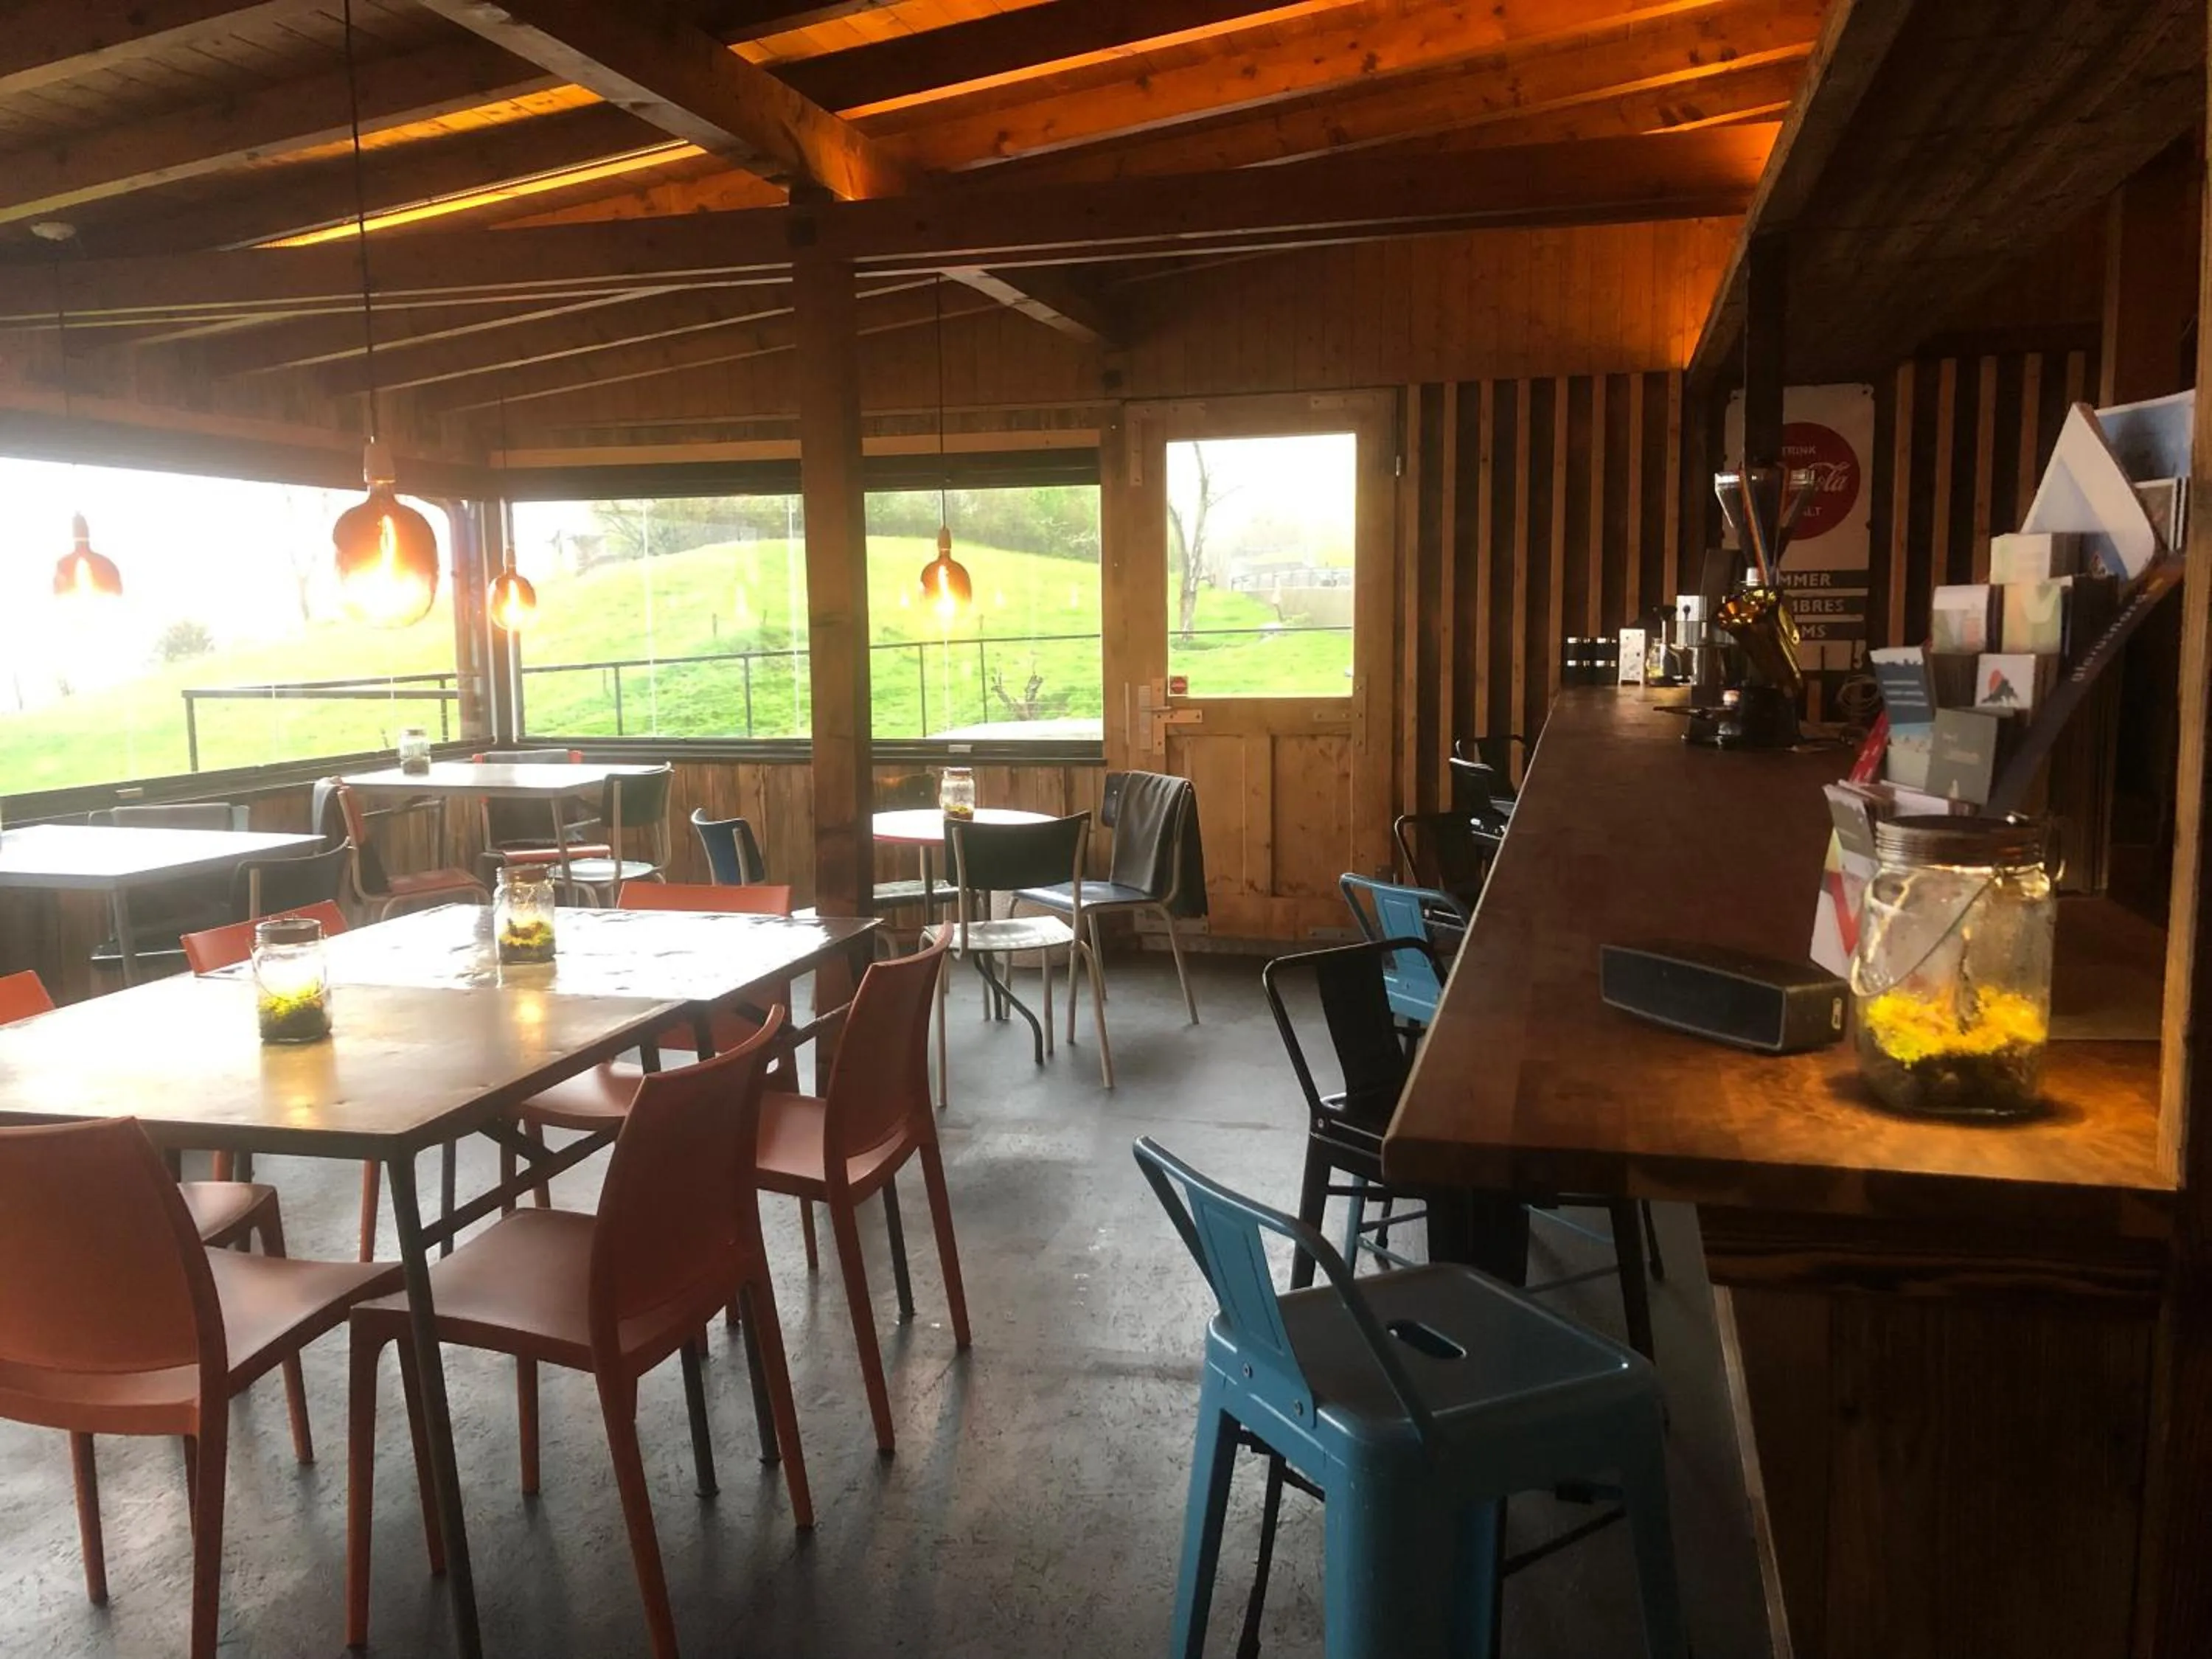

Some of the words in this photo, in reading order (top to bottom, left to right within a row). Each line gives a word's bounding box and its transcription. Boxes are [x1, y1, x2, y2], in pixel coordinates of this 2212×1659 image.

[1779, 573, 1832, 587] MMER
[1792, 599, 1845, 613] BRES
[1801, 624, 1826, 638] MS
